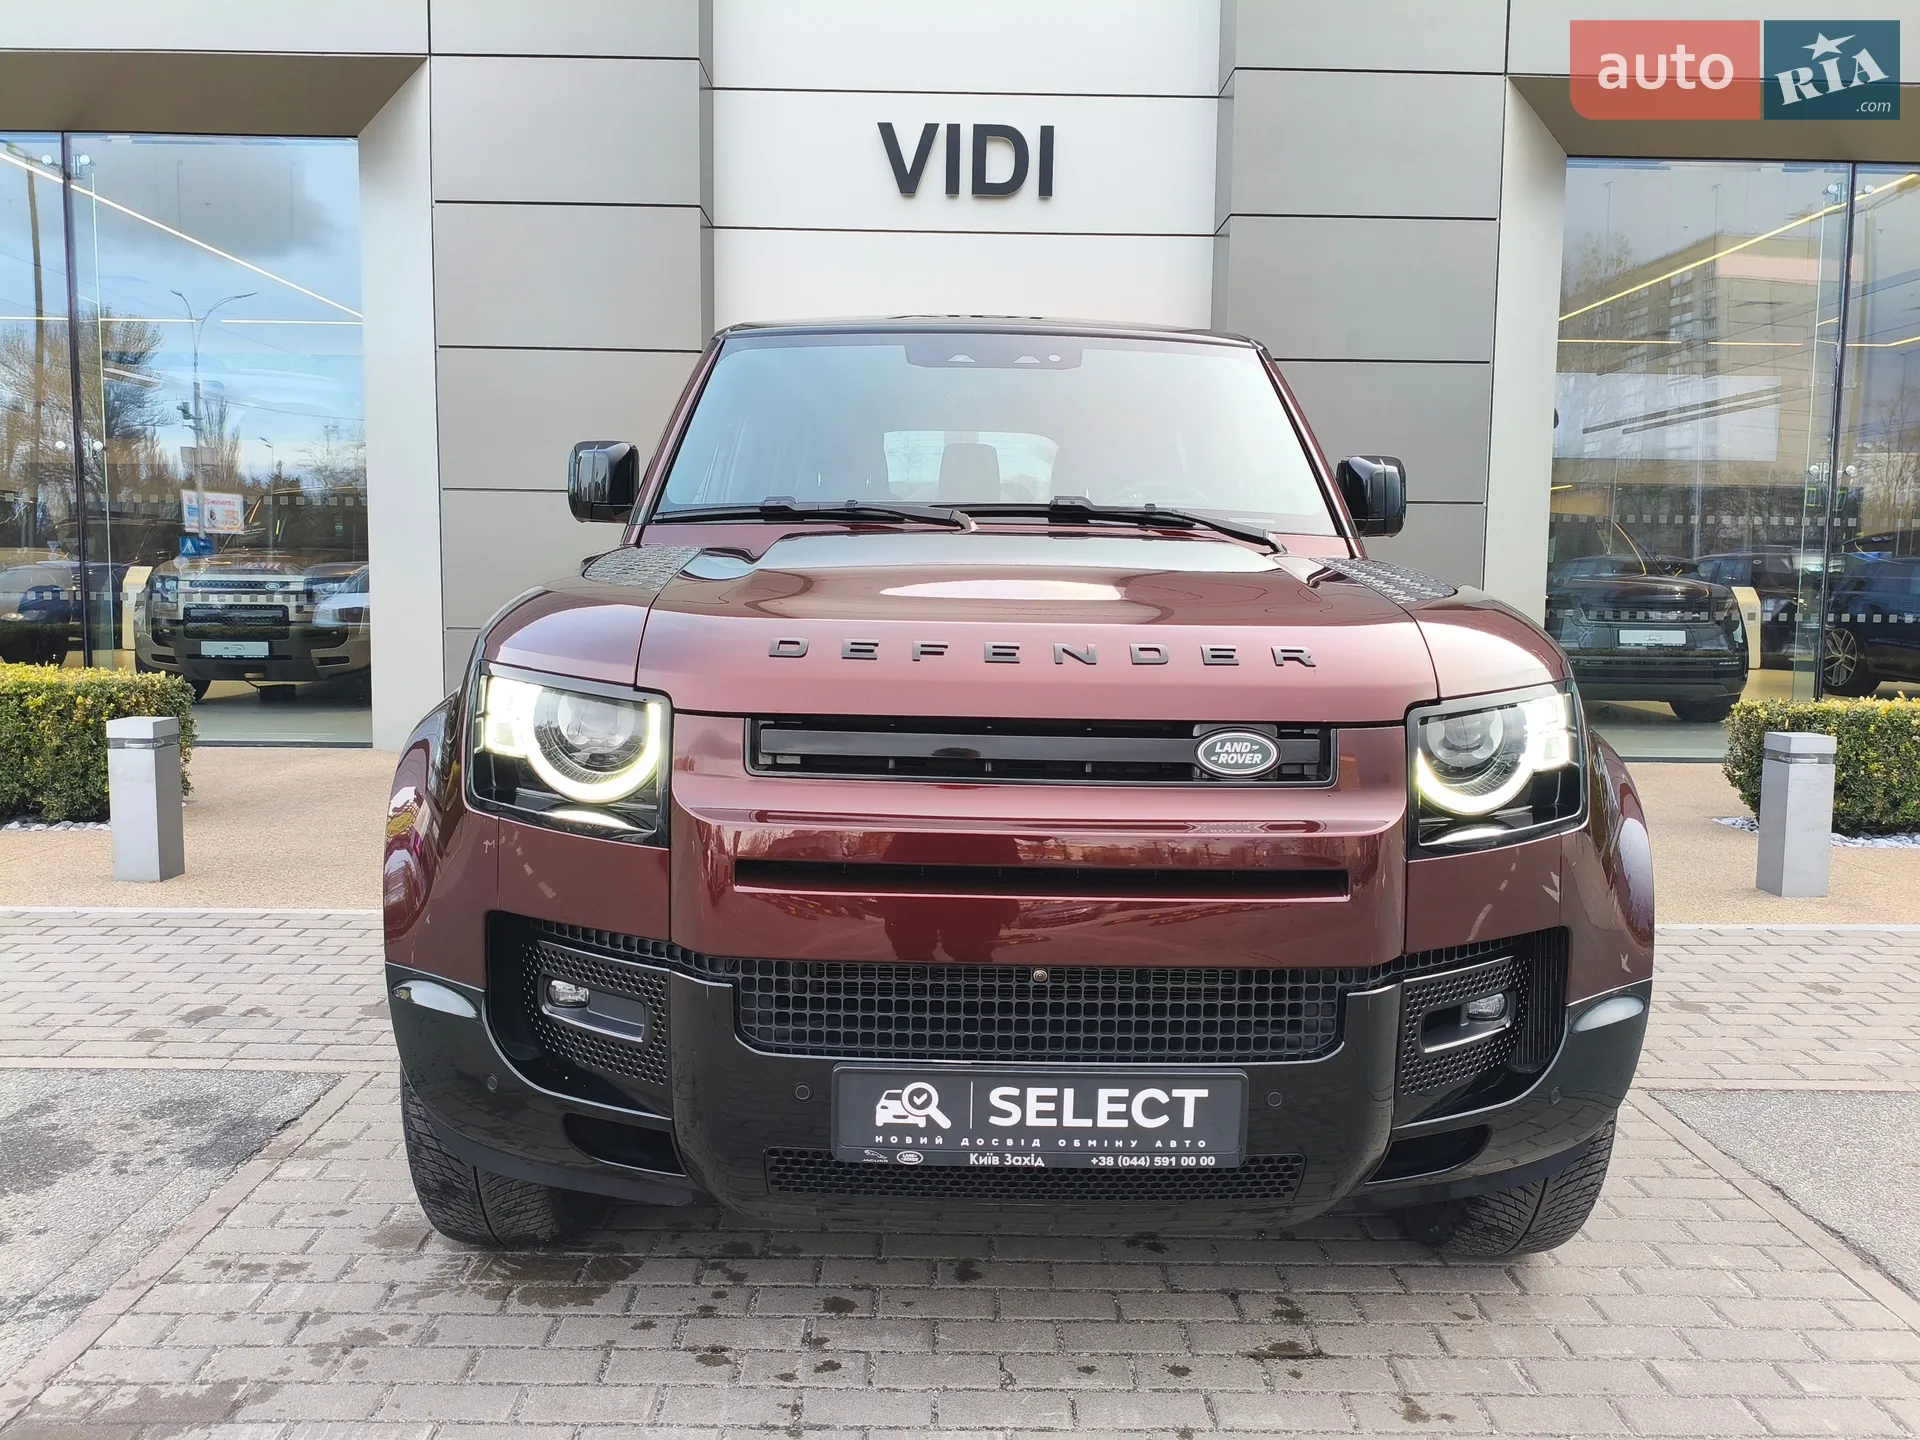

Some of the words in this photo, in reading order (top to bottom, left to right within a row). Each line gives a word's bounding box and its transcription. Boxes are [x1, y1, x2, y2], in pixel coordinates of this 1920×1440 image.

[877, 122, 1055, 198] VIDI
[768, 636, 1317, 668] DEFENDER
[1214, 742, 1251, 753] LAND
[1217, 753, 1262, 764] ROVER
[988, 1086, 1209, 1128] SELECT
[875, 1135, 943, 1145] НОВИЙ
[961, 1138, 1041, 1148] ДОСВІД
[1058, 1139, 1138, 1148] ОБМІНУ
[1154, 1140, 1206, 1148] АВТО
[969, 1153, 1000, 1165] Київ
[1003, 1153, 1045, 1167] Захід
[1091, 1156, 1114, 1166] +38
[1118, 1155, 1150, 1168] (044)
[1154, 1156, 1176, 1167] 591
[1180, 1156, 1197, 1167] 00
[1199, 1156, 1216, 1167] 00
